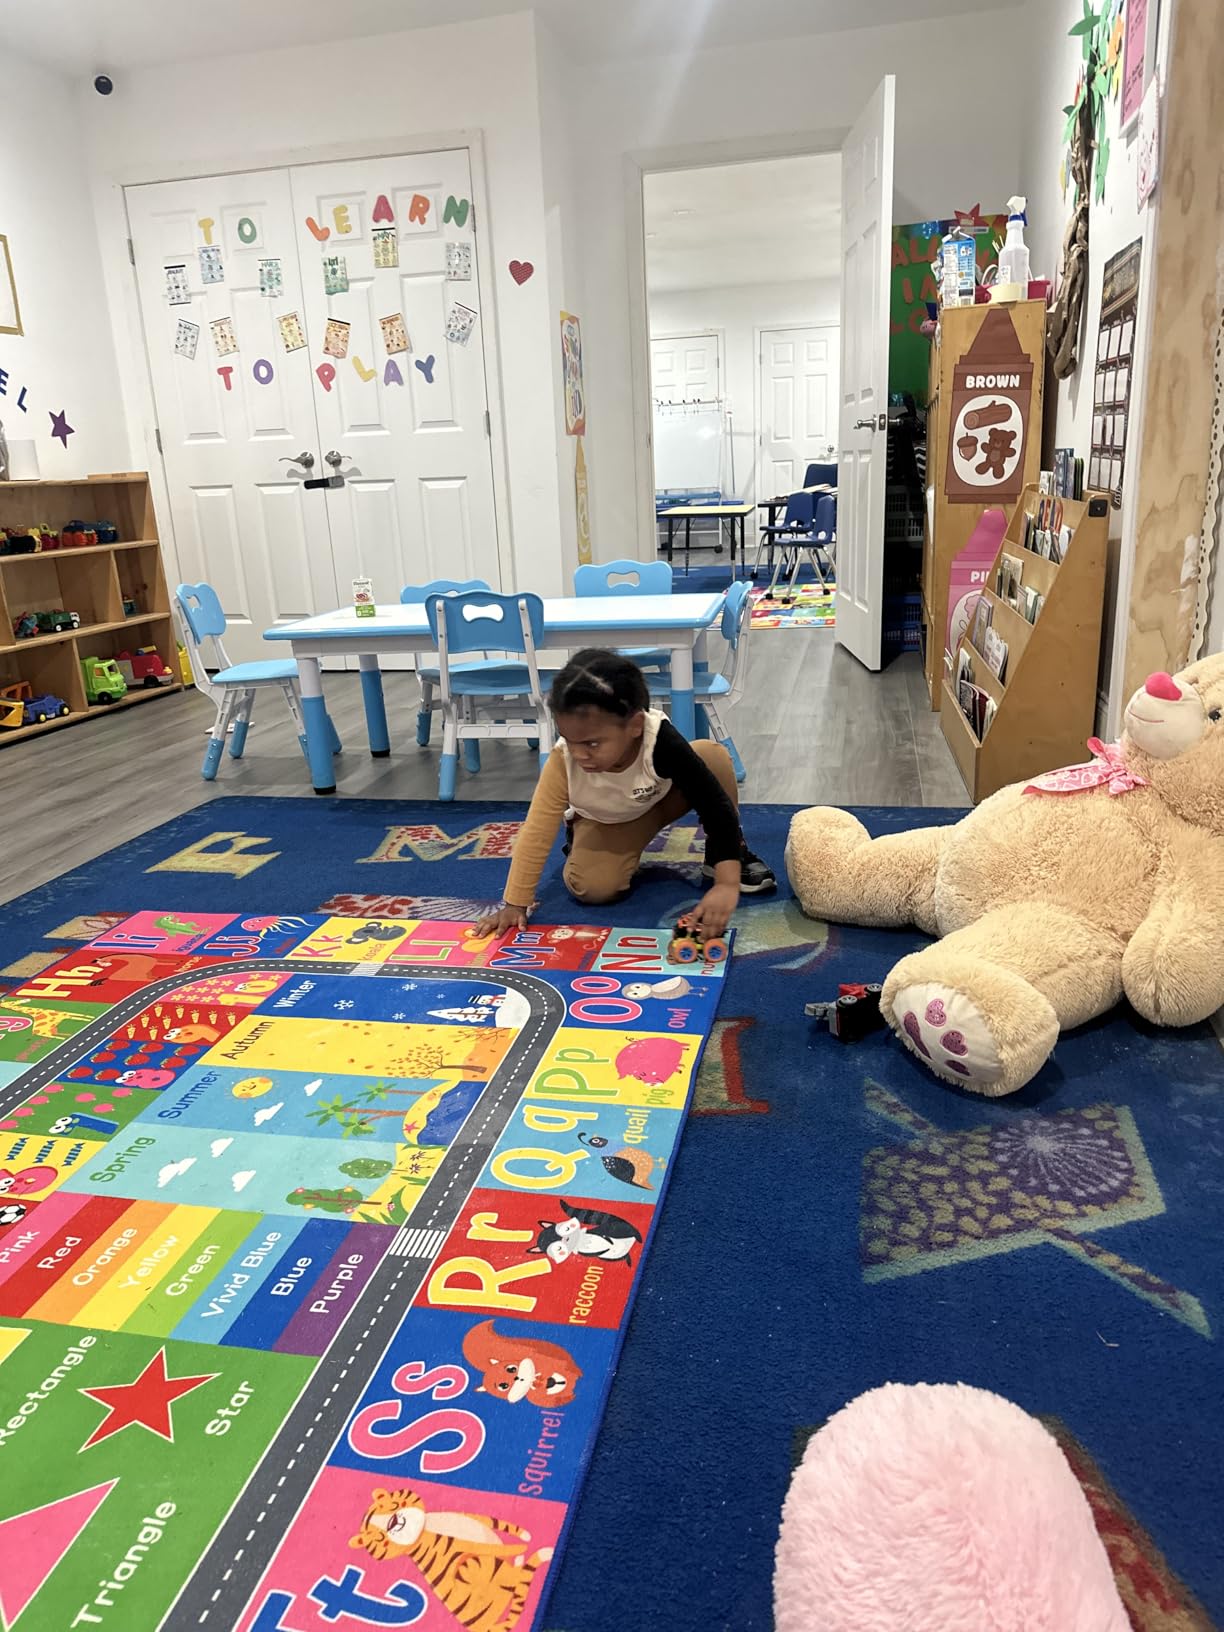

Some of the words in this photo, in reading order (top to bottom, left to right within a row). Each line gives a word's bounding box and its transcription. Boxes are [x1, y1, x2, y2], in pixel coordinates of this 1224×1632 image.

[198, 217, 258, 245] TO
[305, 194, 470, 241] LEARN
[217, 359, 274, 391] TO
[316, 355, 435, 392] PLAY
[966, 374, 1020, 388] BROWN
[970, 570, 991, 583] PI
[203, 935, 261, 957] Jj
[290, 935, 344, 958] Kk
[389, 939, 460, 961] Ll
[490, 931, 556, 967] Mm
[599, 936, 663, 972] Nn
[16, 965, 104, 997] Hh
[273, 979, 318, 1009] Winter
[569, 975, 643, 1024] Oo
[219, 1021, 276, 1060] Autumn
[666, 1007, 692, 1029] owl
[157, 1071, 223, 1119] Summer
[532, 1047, 620, 1096] Pp
[643, 1087, 675, 1105] pig
[490, 1104, 599, 1190] Qq
[622, 1108, 652, 1144] quail
[89, 1136, 156, 1183] Spring
[0, 1231, 40, 1263] Pink
[36, 1236, 82, 1269] Red
[72, 1227, 138, 1287] Orange
[118, 1234, 180, 1289] Yellow
[165, 1244, 220, 1296] Green
[427, 1212, 552, 1313] Rr
[201, 1273, 250, 1318] Vivid
[240, 1231, 282, 1269] Blue
[271, 1256, 312, 1296] Blue
[309, 1254, 364, 1314] Purple
[568, 1265, 604, 1325] raccoon
[0, 1335, 97, 1445] Rectangle
[205, 1380, 256, 1436] Star
[348, 1361, 487, 1474] Ss
[518, 1409, 565, 1496] squirrel
[70, 1501, 177, 1629] Triangle
